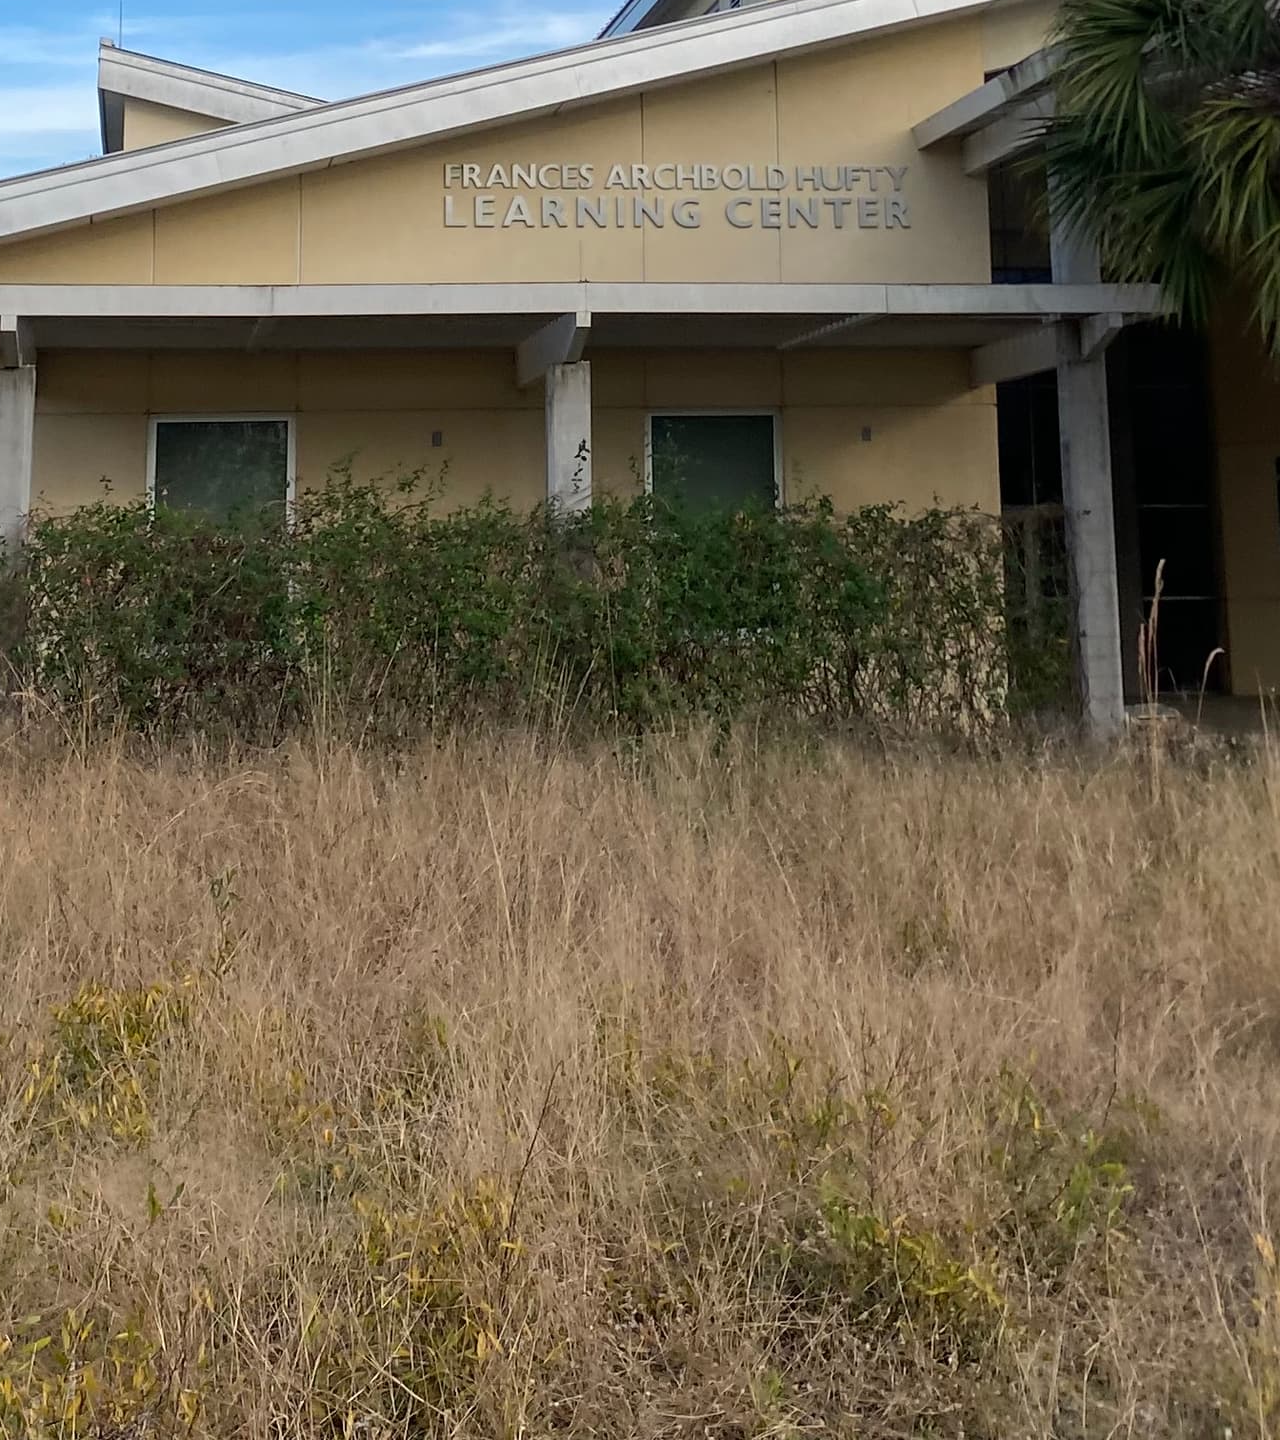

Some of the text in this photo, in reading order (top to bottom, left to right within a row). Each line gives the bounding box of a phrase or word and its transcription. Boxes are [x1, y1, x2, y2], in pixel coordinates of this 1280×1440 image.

[443, 163, 909, 191] FRANCES ARCHBOLD HUFTY
[443, 195, 912, 229] LEARNING CENTER
